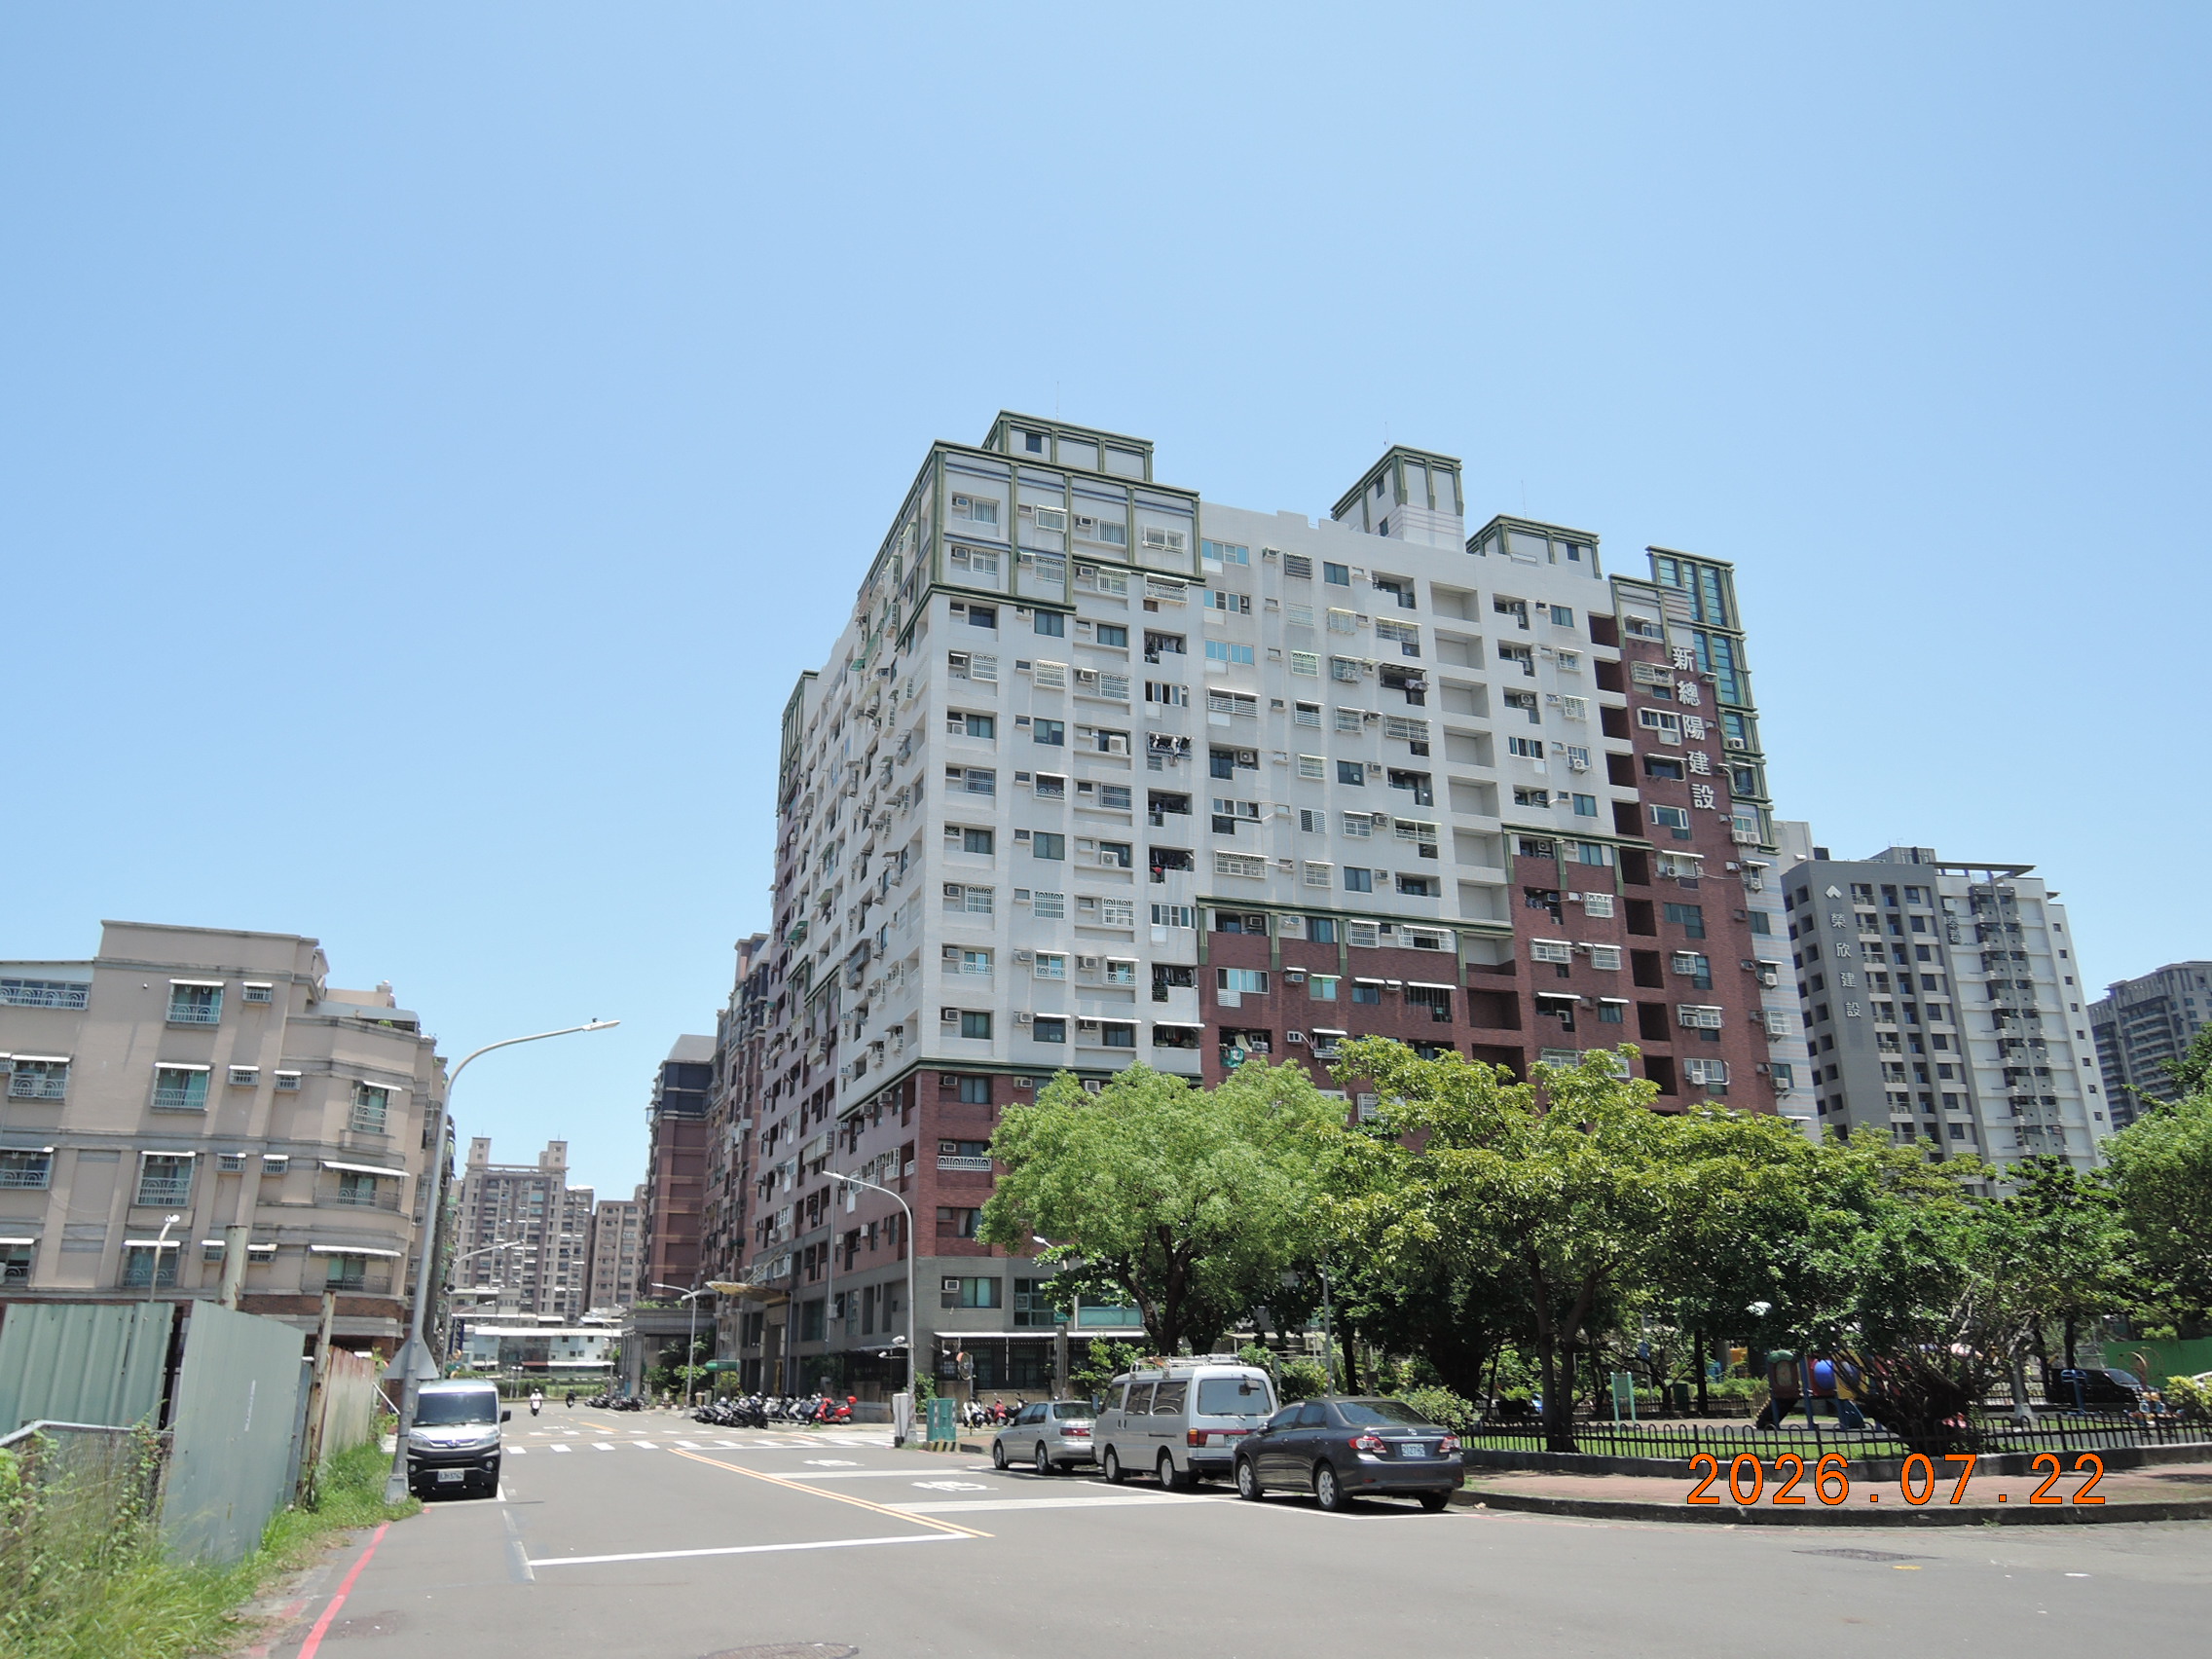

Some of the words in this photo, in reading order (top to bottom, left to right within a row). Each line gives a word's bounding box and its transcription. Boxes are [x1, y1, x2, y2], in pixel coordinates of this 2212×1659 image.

[1673, 647, 1715, 810] 新總陽建設
[1831, 913, 1862, 1017] 榮欣建設
